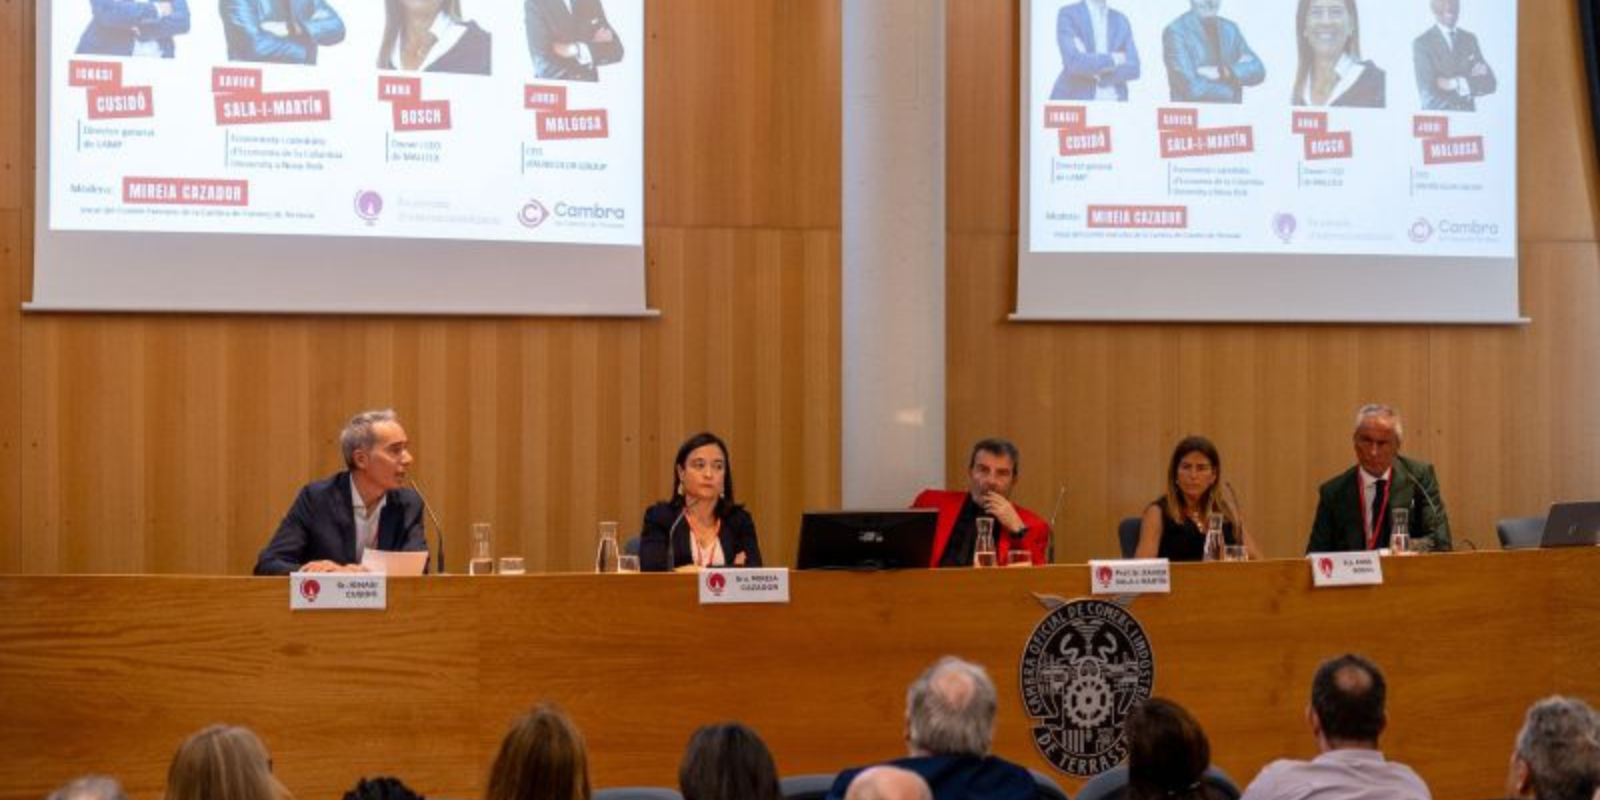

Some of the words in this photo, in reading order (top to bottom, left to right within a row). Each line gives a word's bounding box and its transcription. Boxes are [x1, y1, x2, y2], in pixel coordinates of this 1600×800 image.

[223, 97, 322, 118] SALA-I-MARTÍN
[400, 108, 441, 125] BOSCH
[544, 115, 602, 132] MALGOSA
[128, 182, 177, 199] MIREIA
[181, 184, 241, 201] CAZADOR
[553, 200, 625, 220] Cambra
[1438, 218, 1499, 237] Cambra
[1030, 610, 1069, 654] OFICIAL
[1067, 603, 1083, 618] DE
[1037, 734, 1059, 756] DE
[1059, 736, 1130, 775] TERRASS
